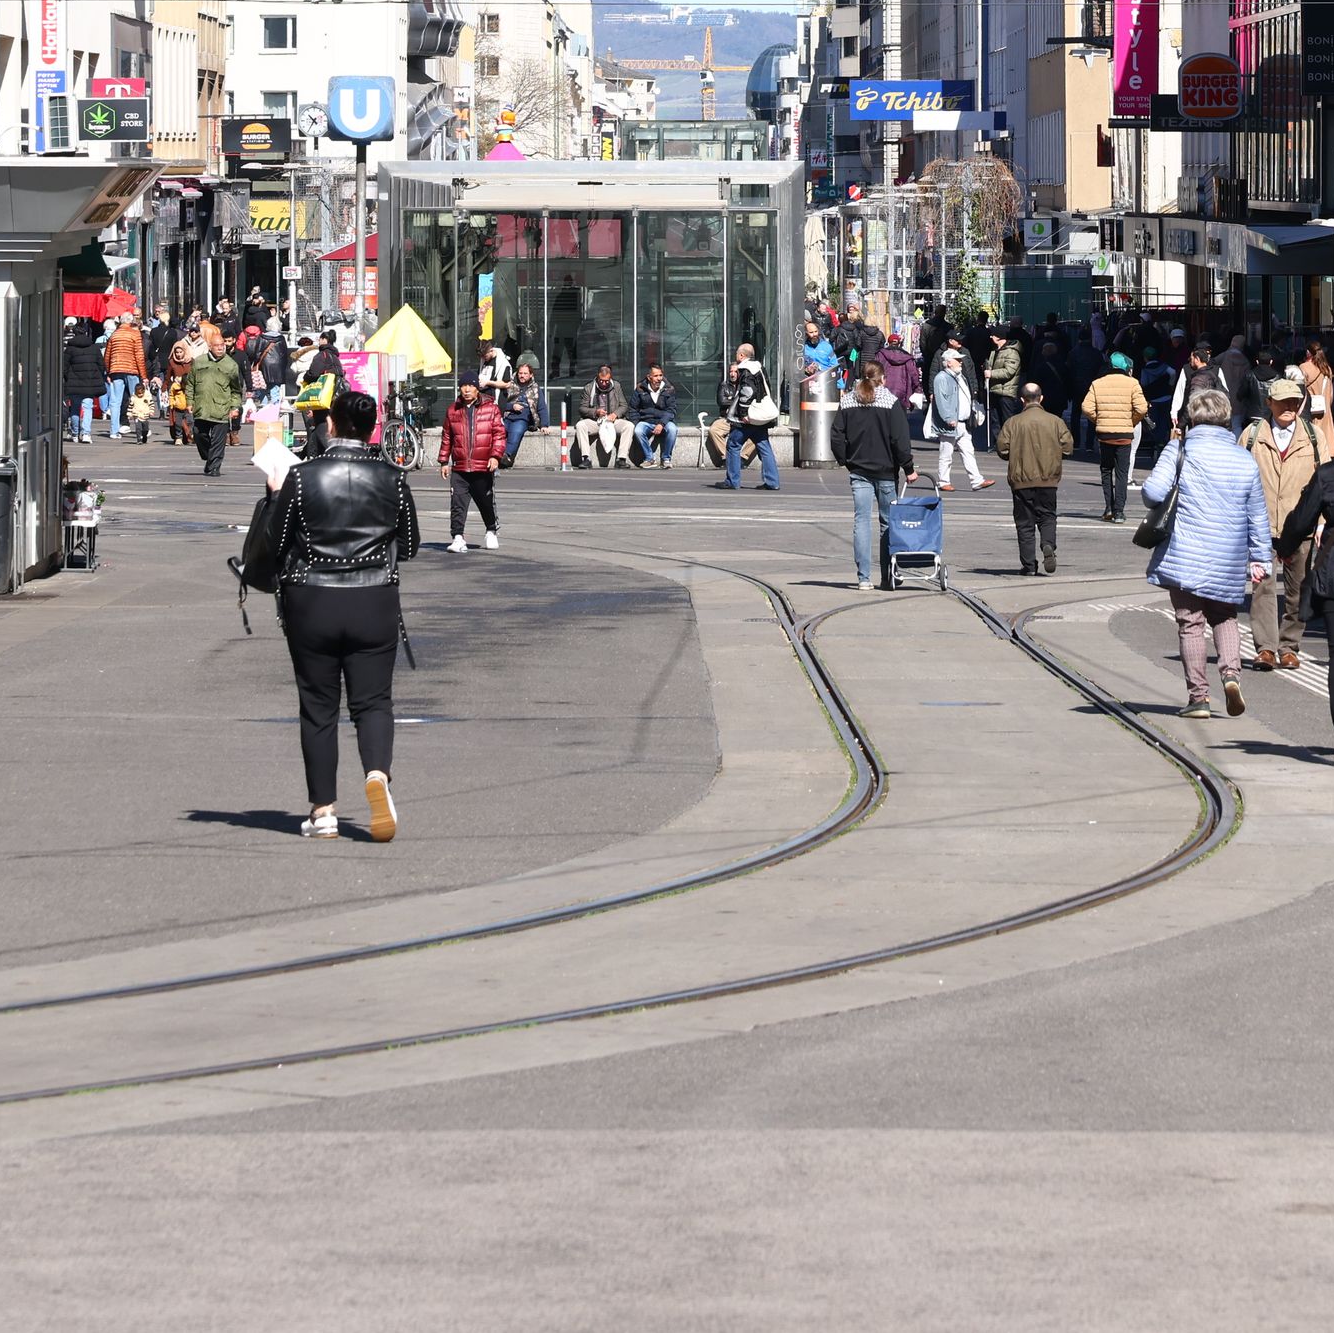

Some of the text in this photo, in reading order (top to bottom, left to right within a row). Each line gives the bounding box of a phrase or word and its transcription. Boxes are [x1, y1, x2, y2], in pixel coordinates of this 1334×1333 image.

[1182, 74, 1238, 88] BURGER
[881, 91, 970, 111] Tchibo
[1182, 89, 1238, 107] KING
[124, 112, 140, 120] CBD
[339, 88, 381, 133] U
